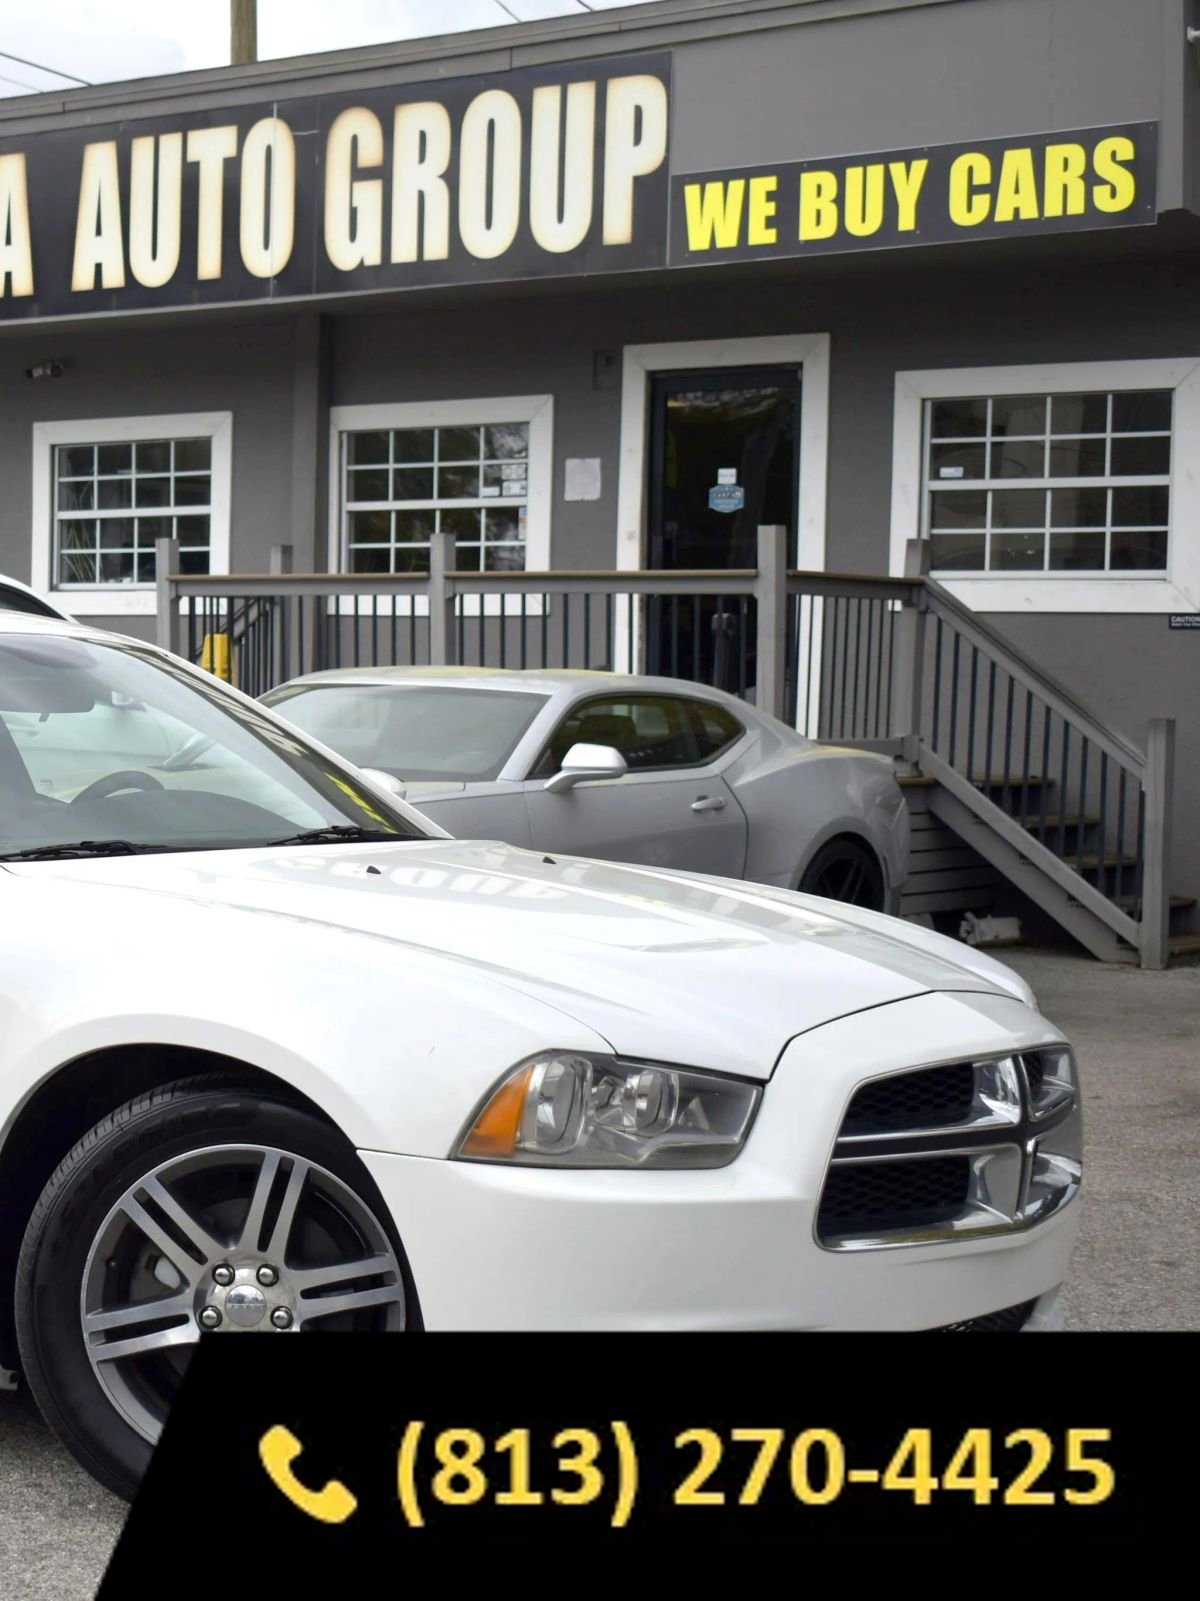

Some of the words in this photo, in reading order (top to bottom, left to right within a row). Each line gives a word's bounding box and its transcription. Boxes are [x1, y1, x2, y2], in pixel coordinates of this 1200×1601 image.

[71, 117, 295, 292] AUTO
[324, 74, 667, 271] GROUP
[684, 175, 777, 252] WE
[799, 159, 928, 241] BUY
[949, 136, 1135, 226] CARS
